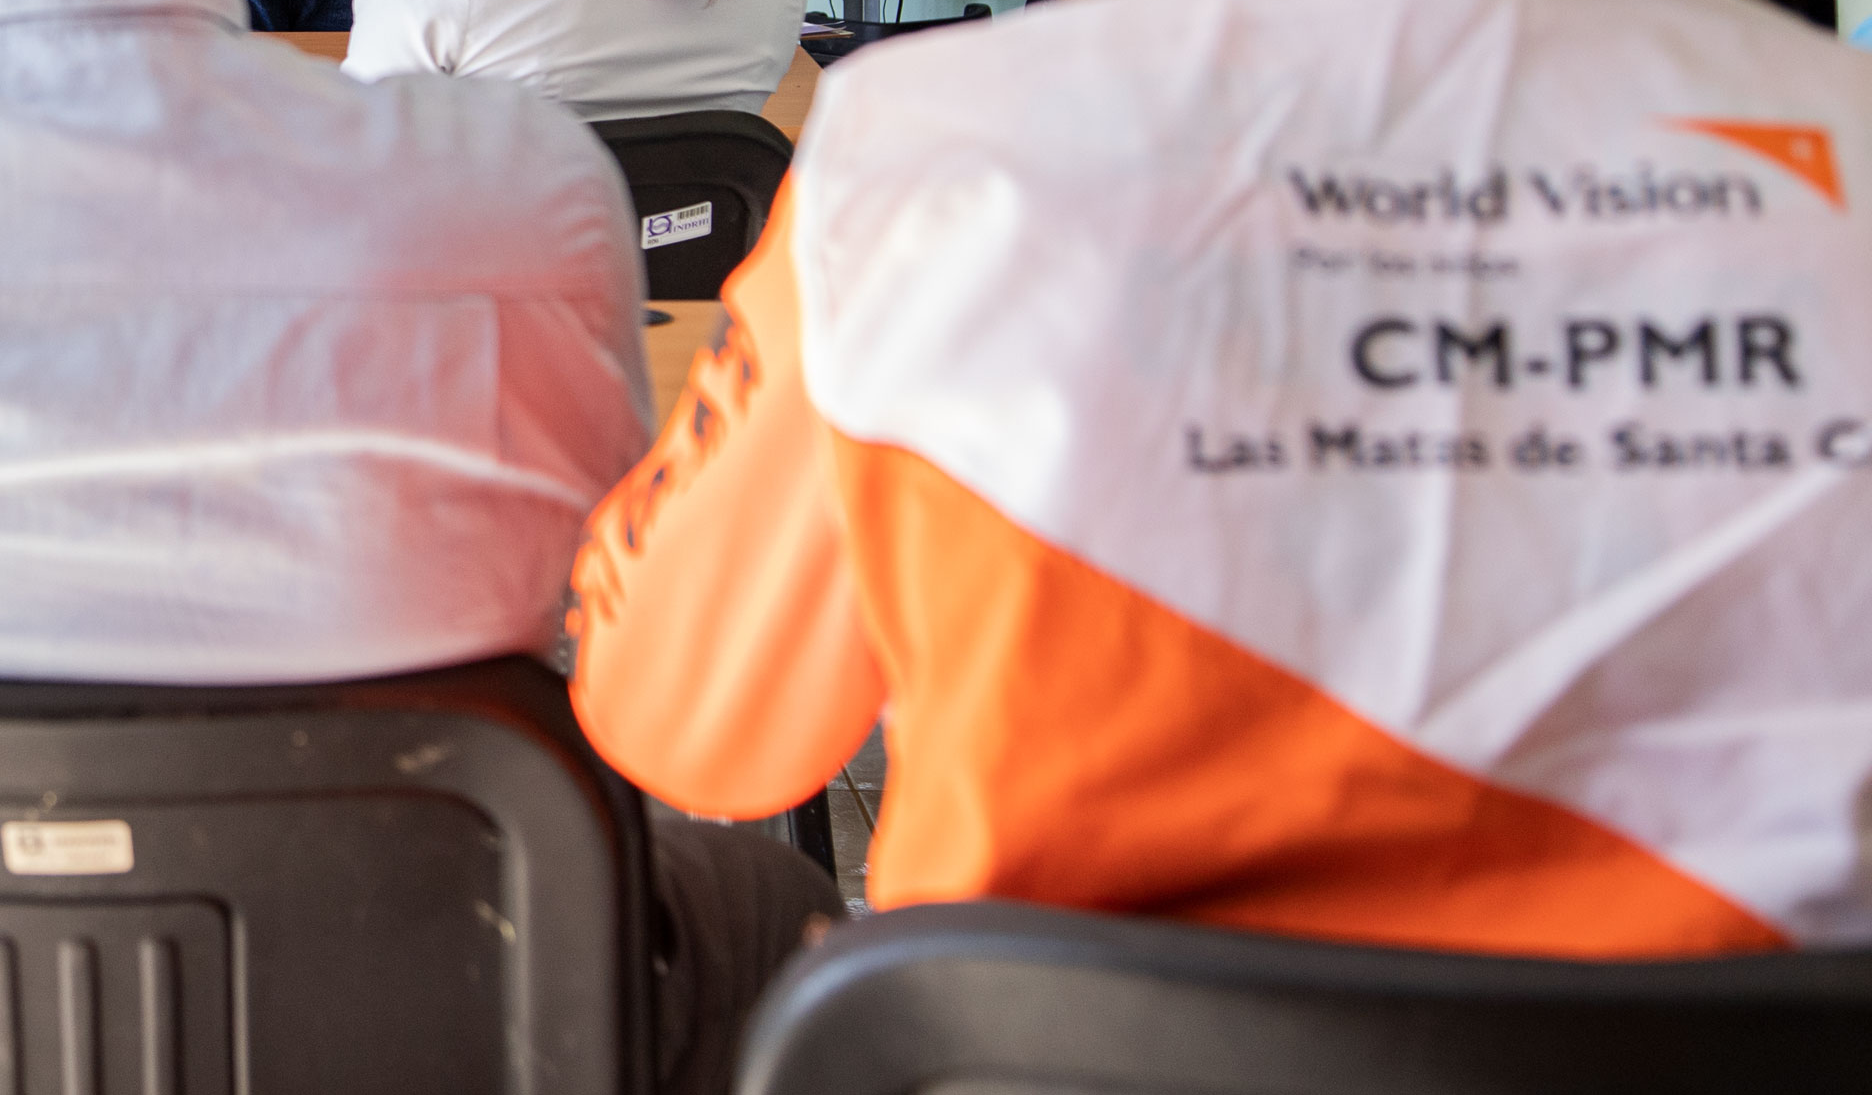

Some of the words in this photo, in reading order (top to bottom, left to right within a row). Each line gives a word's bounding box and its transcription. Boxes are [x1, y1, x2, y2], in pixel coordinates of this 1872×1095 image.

[1289, 167, 1509, 225] World
[1528, 165, 1762, 218] Vision
[1349, 315, 1802, 392] CM-PMR
[1186, 425, 1285, 474] Las
[1509, 424, 1580, 472] de
[1612, 422, 1791, 471] Santa
